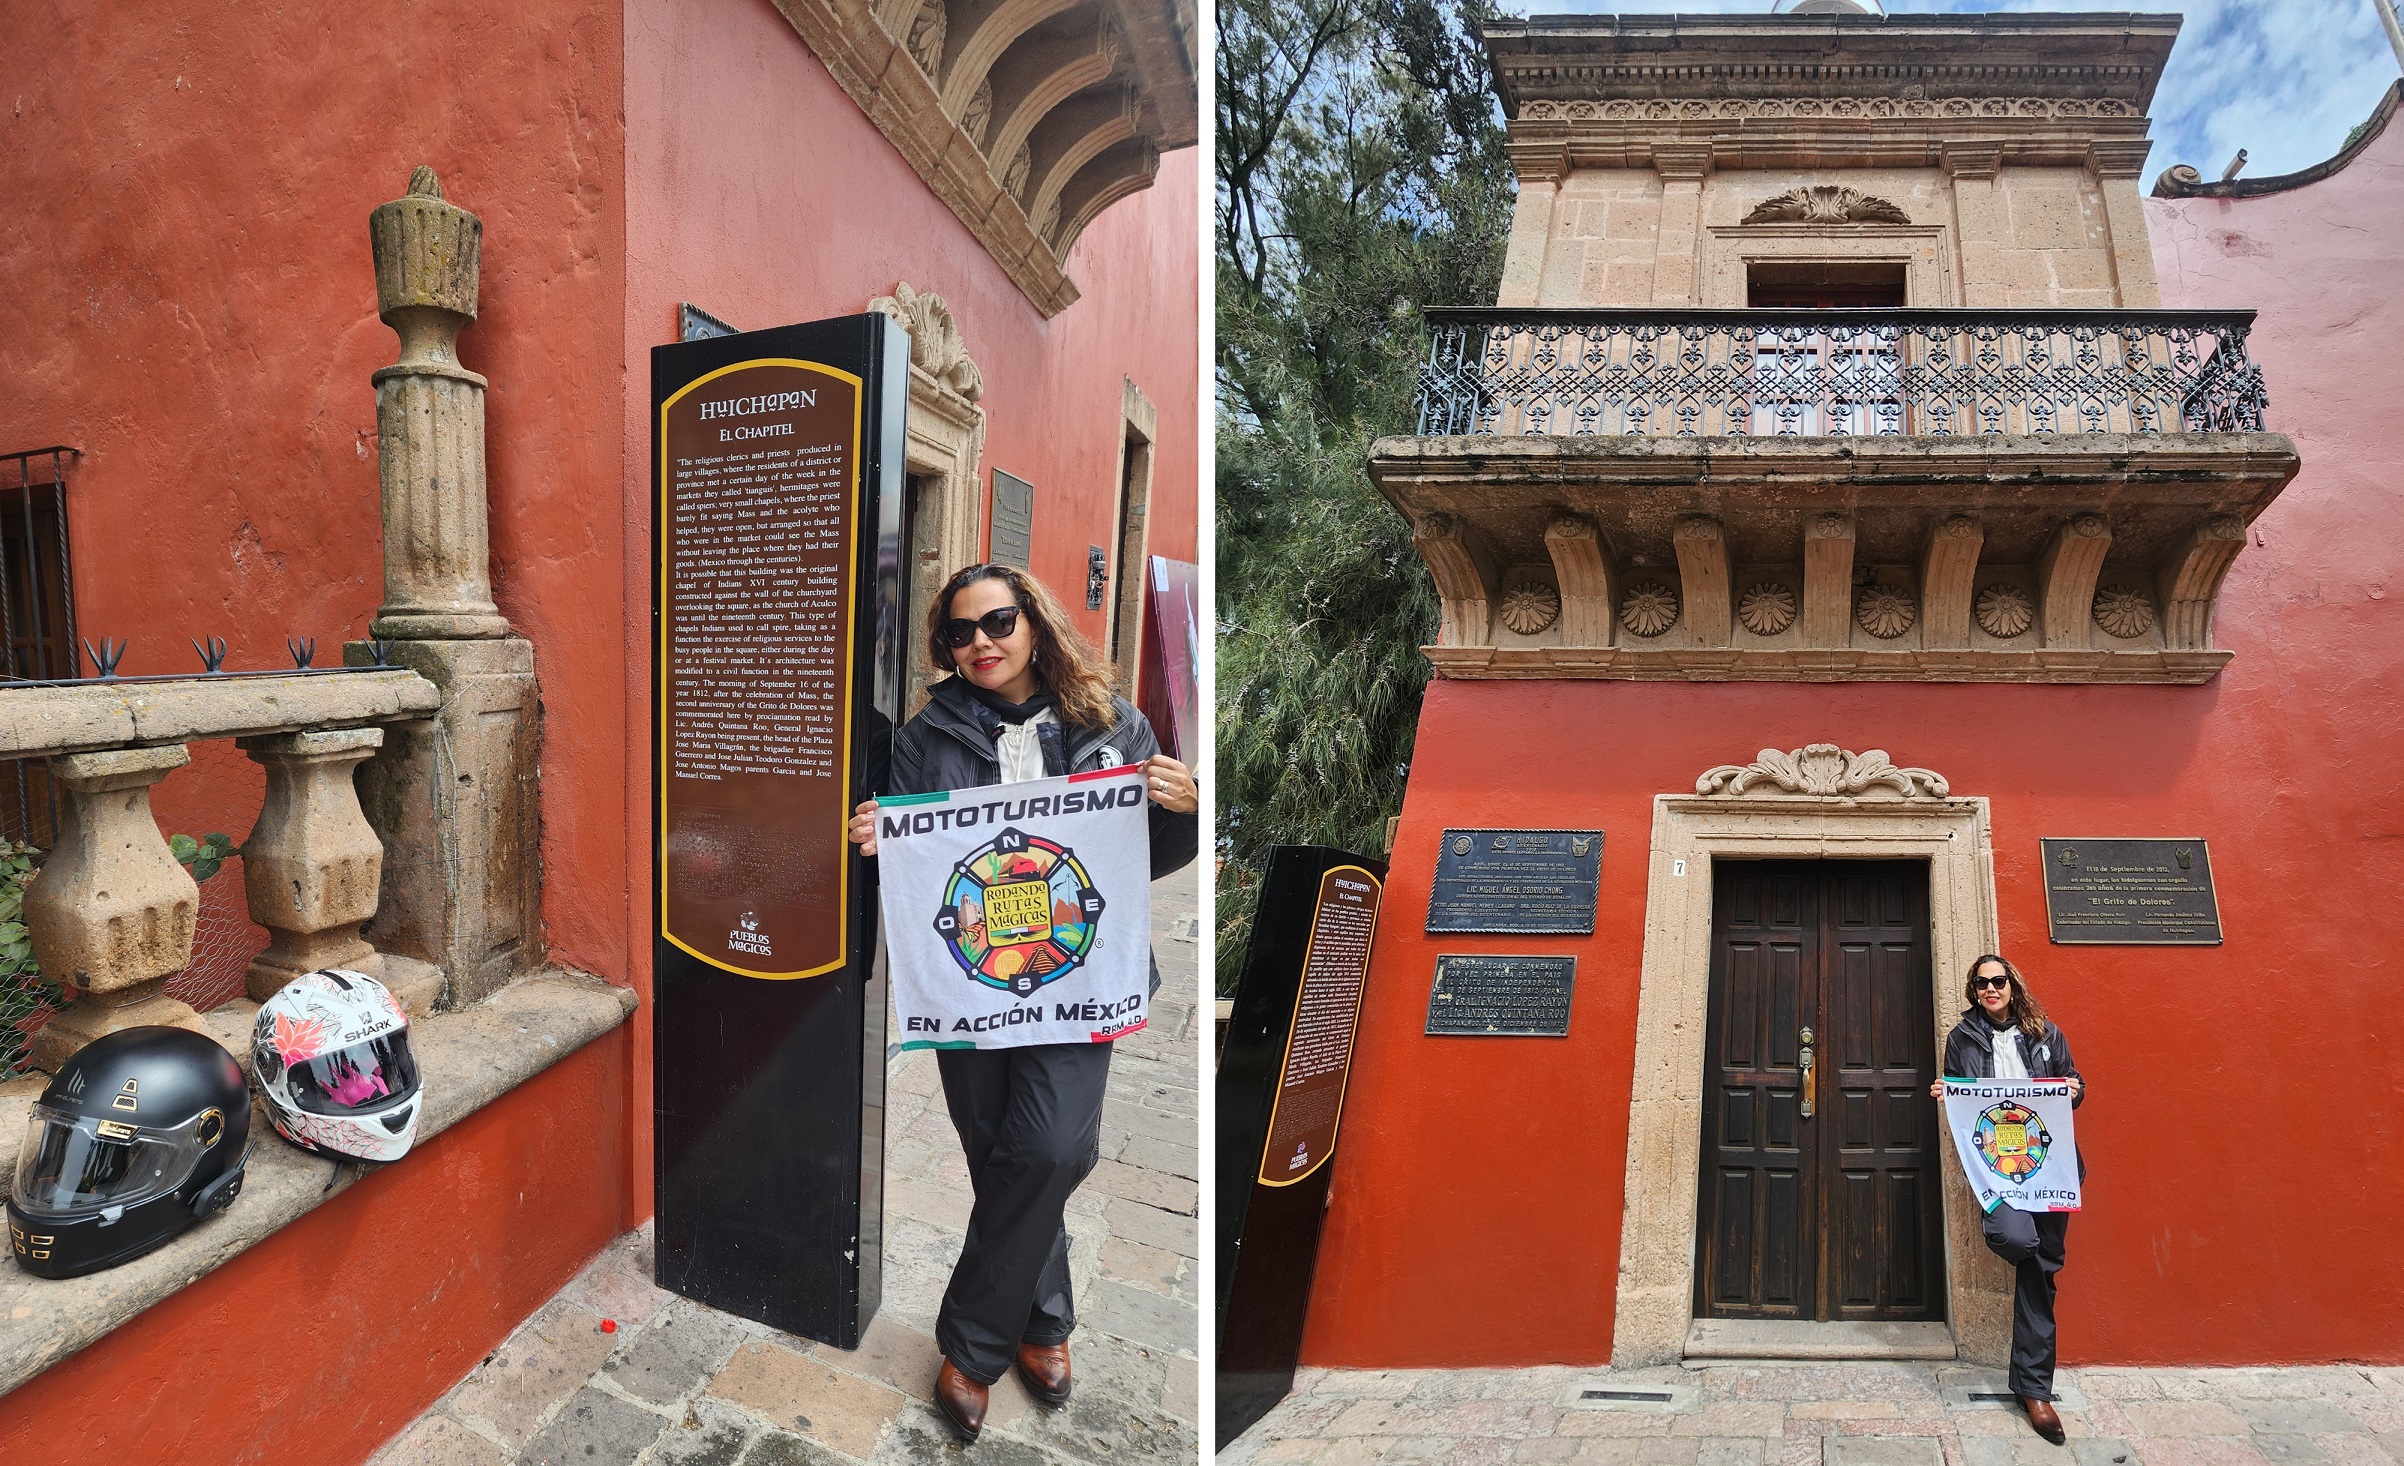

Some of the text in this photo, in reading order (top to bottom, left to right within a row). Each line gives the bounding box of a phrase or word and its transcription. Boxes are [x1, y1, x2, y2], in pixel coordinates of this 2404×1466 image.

[695, 456, 724, 466] religious
[726, 452, 749, 462] clerics
[751, 450, 765, 459] and
[766, 449, 791, 460] priests
[796, 443, 831, 457] produced
[834, 443, 842, 451] in
[676, 491, 702, 500] markets
[704, 490, 719, 499] they
[721, 487, 742, 496] called
[779, 482, 820, 492] hermitages
[676, 502, 696, 511] called
[718, 501, 734, 509] very
[734, 498, 753, 507] small
[783, 494, 806, 503] where
[806, 493, 819, 502] the
[819, 492, 840, 503] priest
[675, 576, 838, 591] chapel of Indians XVI century building
[675, 587, 838, 601] constructed against the wall of the churchyard
[721, 612, 756, 621] nineteenth
[789, 611, 806, 620] This
[808, 612, 825, 621] type
[827, 610, 837, 619] of
[714, 635, 742, 643] exercise
[742, 634, 752, 643] of
[752, 634, 783, 644] religious
[823, 634, 836, 642] the
[698, 700, 736, 710] anniversary
[758, 701, 778, 709] Grito
[789, 702, 818, 711] Dolores
[744, 712, 753, 721] by
[756, 712, 801, 721] proclamation
[823, 714, 834, 724] by
[674, 750, 703, 759] Guerrero
[717, 752, 732, 760] Jose
[733, 753, 753, 762] Julian
[754, 754, 783, 764] Teodoro
[784, 756, 817, 766] Gonzalez
[818, 758, 832, 766] and
[882, 784, 1143, 838] MOTOTURISMO
[1002, 834, 1020, 848] N
[1676, 862, 1683, 874] 7
[1502, 883, 1520, 894] ÁNGEL
[1084, 898, 1100, 912] E
[938, 916, 955, 930] O
[1017, 978, 1032, 991] S
[907, 994, 1141, 1033] EN ACCIÓN MÉXICO
[344, 1019, 392, 1042] SHARK
[1946, 1086, 2068, 1098] MOTOTURISMO
[2000, 1188, 2029, 1200] CCIÓN
[2035, 1186, 2076, 1200] MÉXICO
